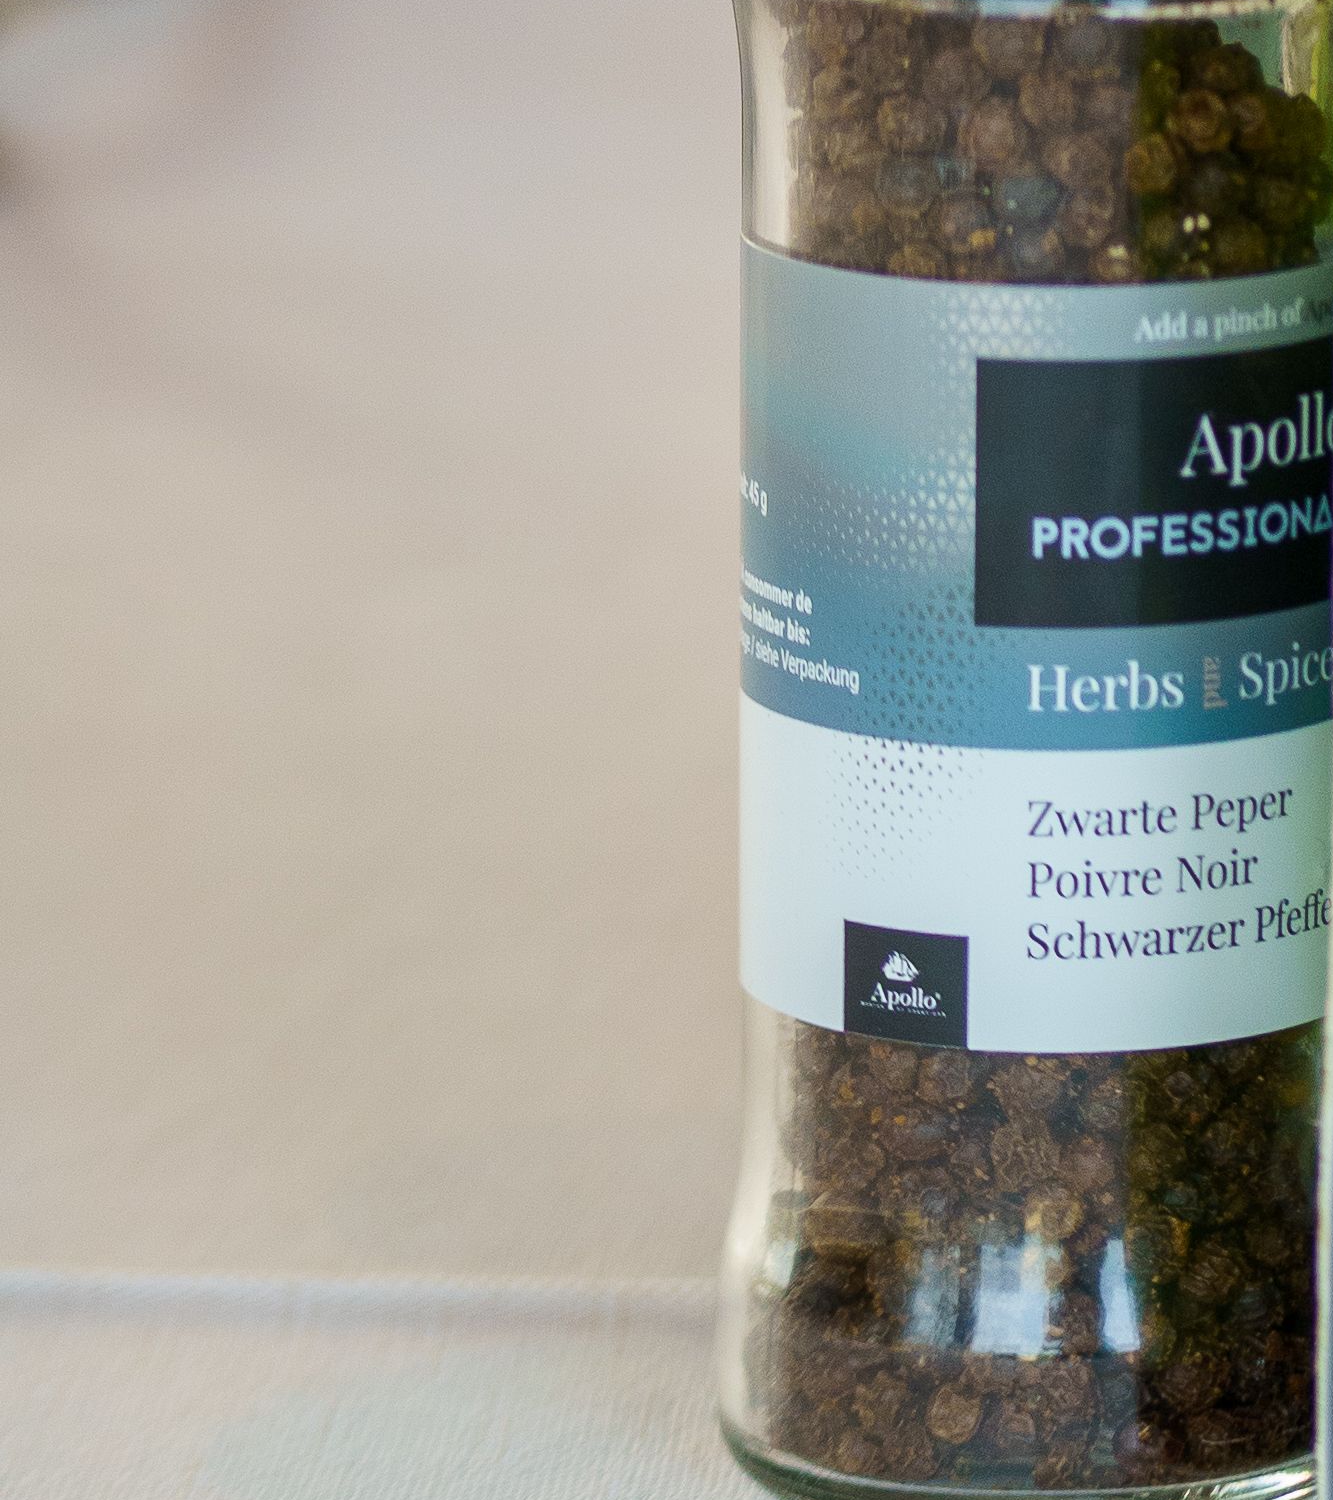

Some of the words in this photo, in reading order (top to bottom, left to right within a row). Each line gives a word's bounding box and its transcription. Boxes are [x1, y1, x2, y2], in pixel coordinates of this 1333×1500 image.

[1135, 311, 1187, 343] Add
[1194, 317, 1209, 337] a
[1214, 304, 1277, 342] pinch
[1281, 296, 1305, 327] of
[796, 587, 813, 615] de
[787, 616, 811, 646] bis:
[756, 638, 780, 668] siehe
[780, 646, 860, 695] Verpackung
[1027, 659, 1184, 712] Herbs
[1027, 799, 1177, 838] Zwarte
[1191, 787, 1294, 833] Peper
[1027, 860, 1162, 899] Poivre
[1176, 848, 1258, 893] Noir
[1027, 919, 1245, 960] Schwarzer
